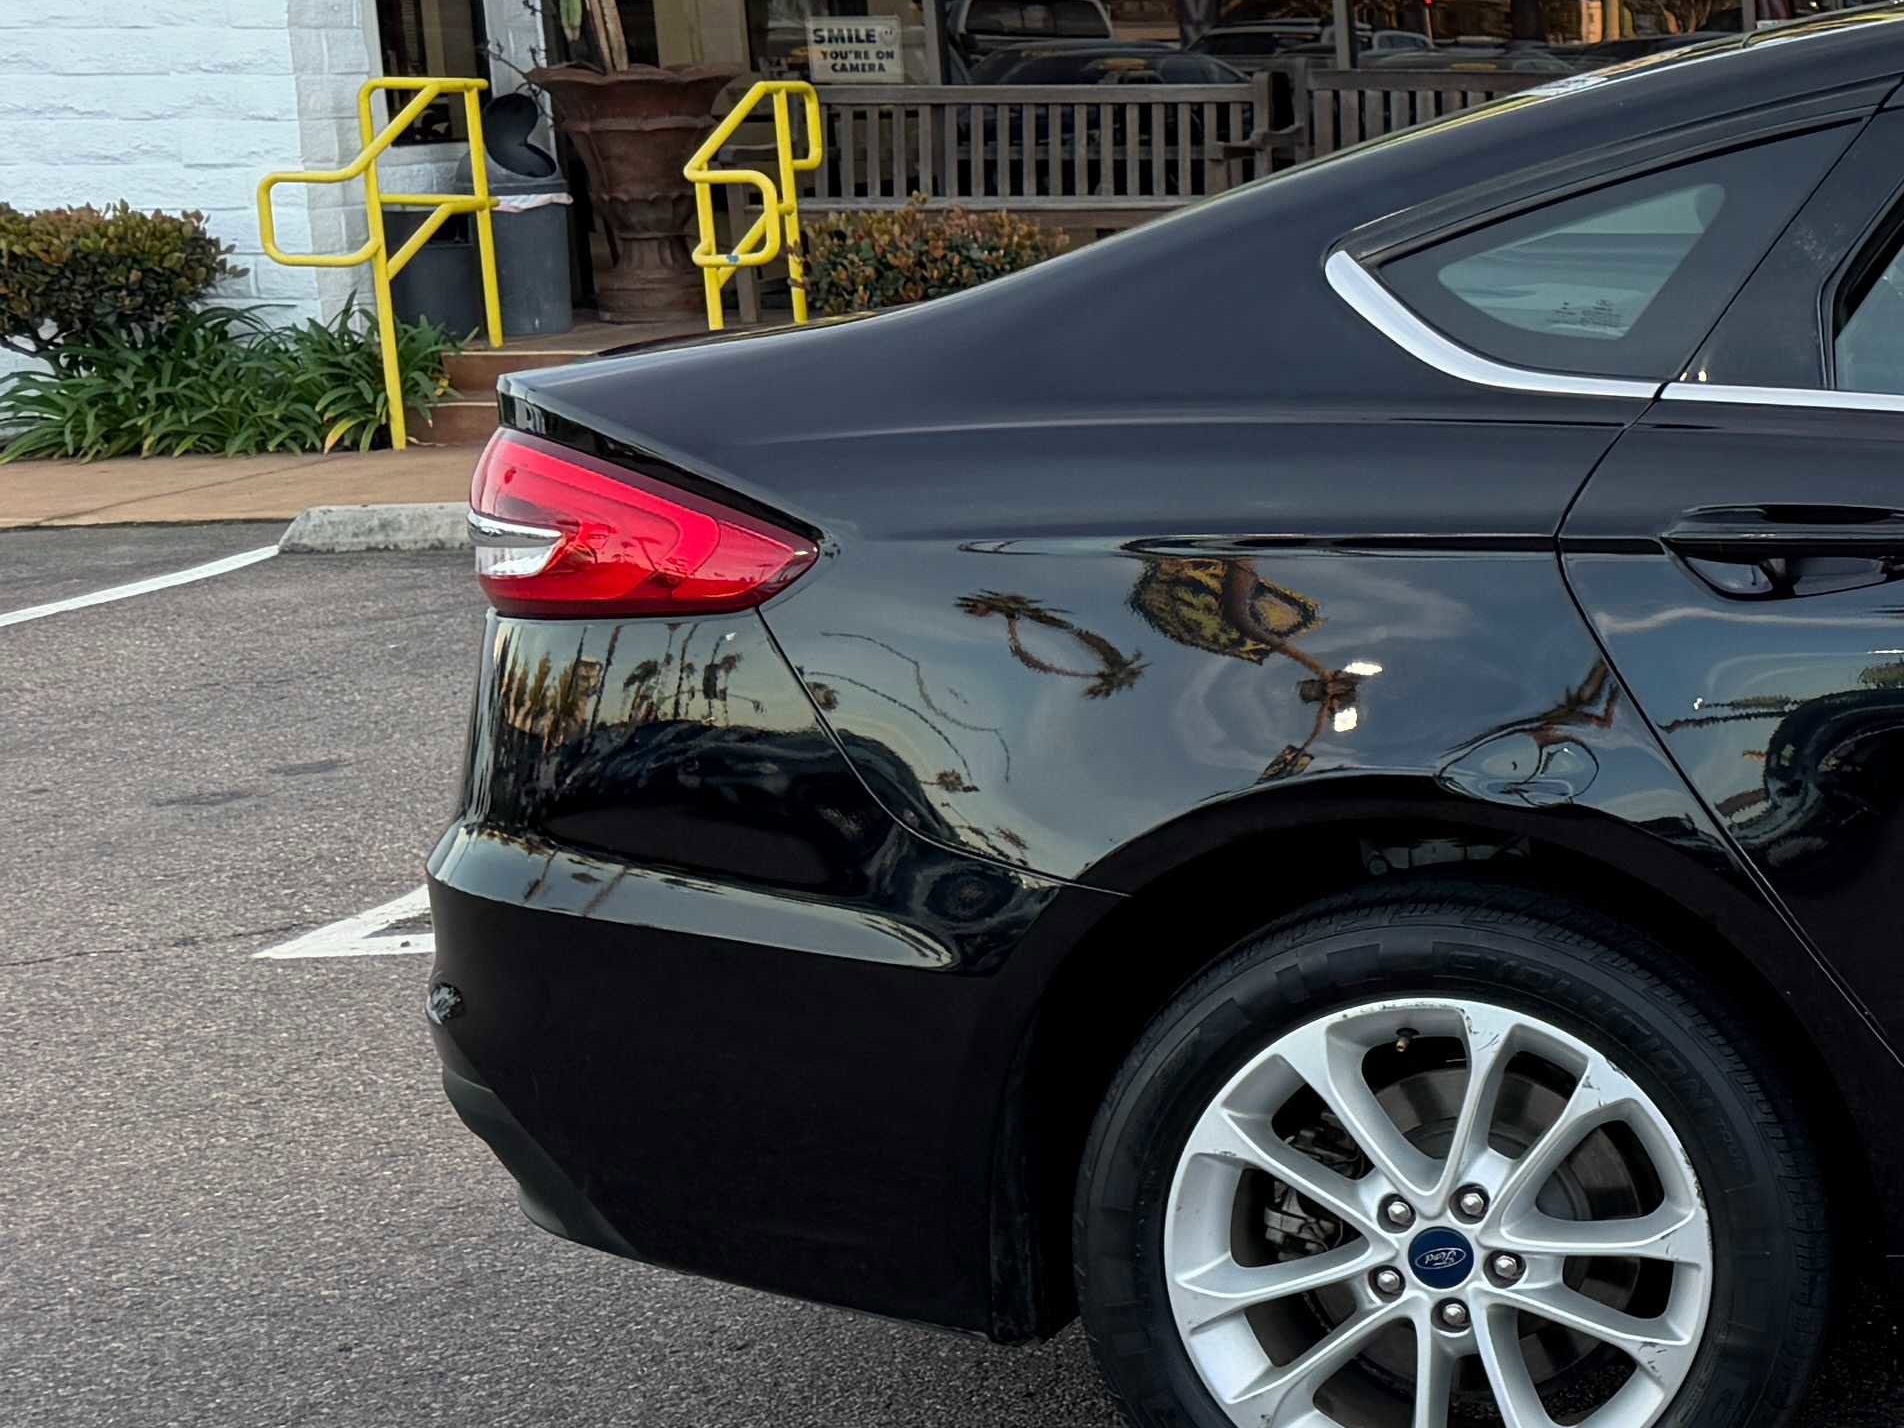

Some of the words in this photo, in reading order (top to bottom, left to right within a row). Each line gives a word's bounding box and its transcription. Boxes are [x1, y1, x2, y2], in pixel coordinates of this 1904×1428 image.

[812, 28, 877, 45] SMILE
[821, 49, 870, 61] YOU'RE
[875, 49, 895, 60] ON
[831, 62, 887, 73] CAMERA
